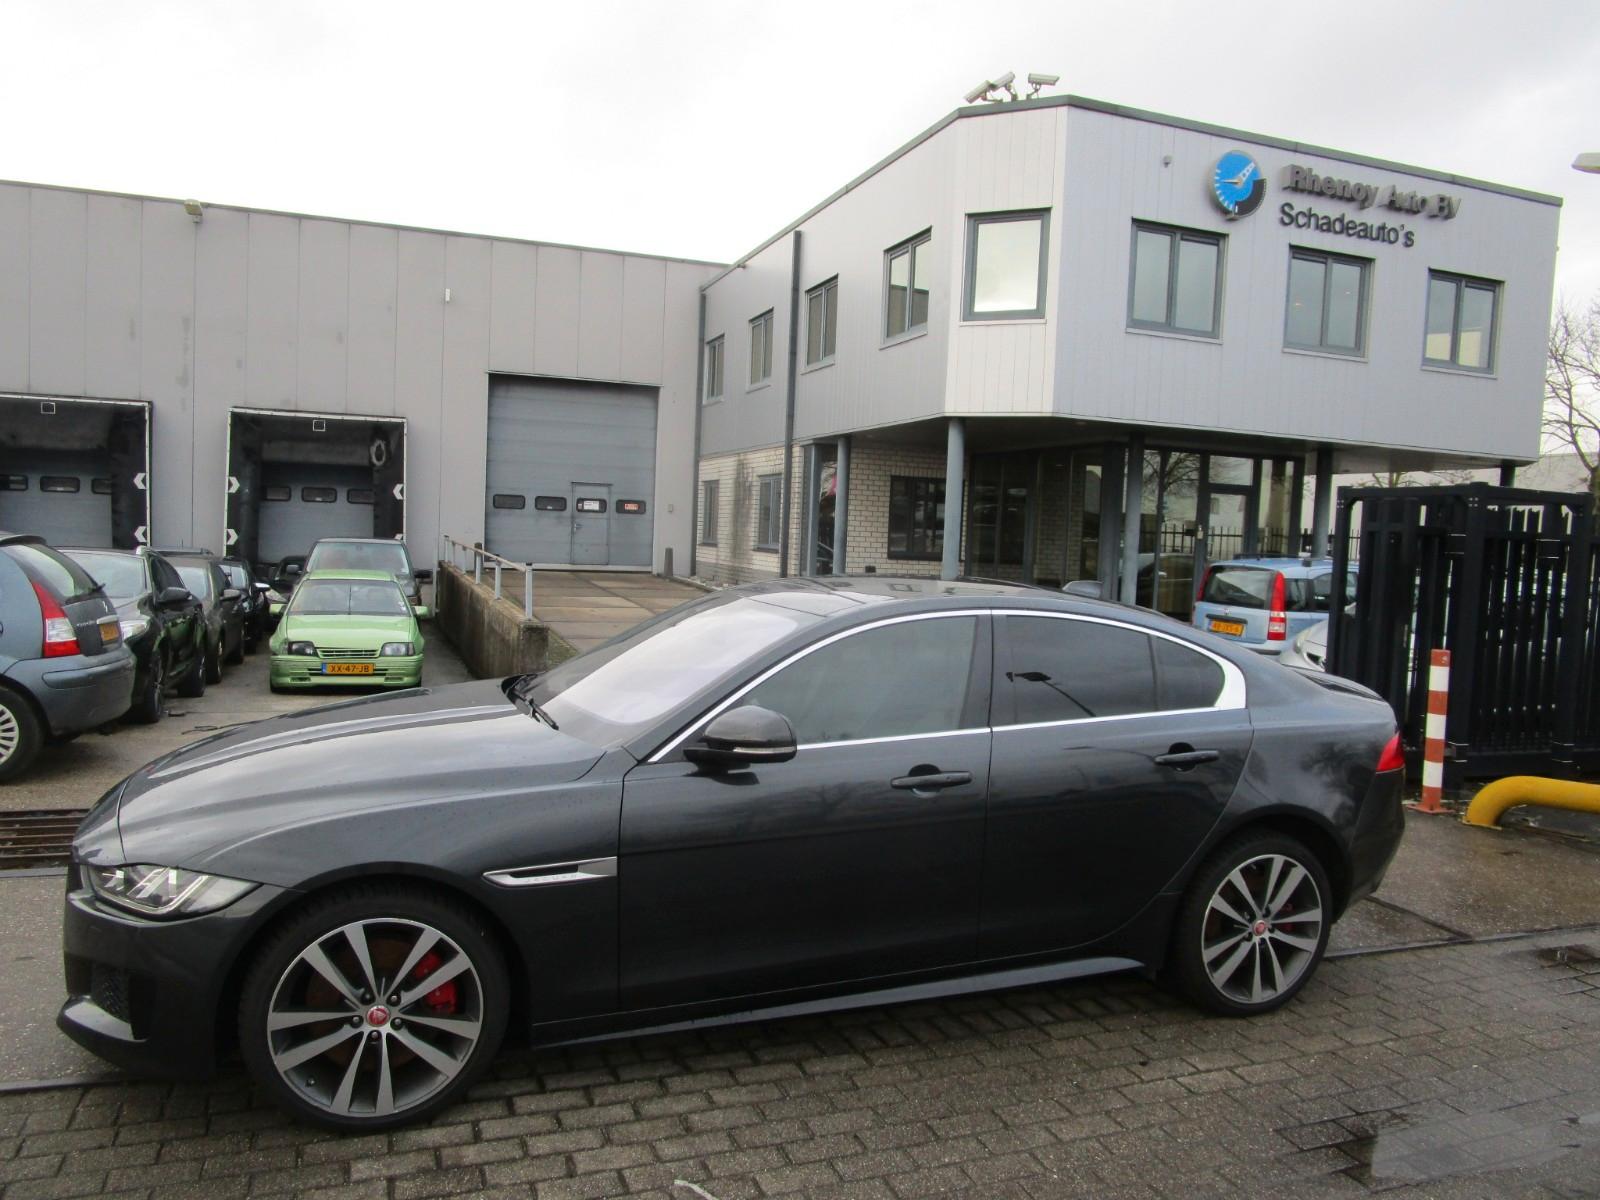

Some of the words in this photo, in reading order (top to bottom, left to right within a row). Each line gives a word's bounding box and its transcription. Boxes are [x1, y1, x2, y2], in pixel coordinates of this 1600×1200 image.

[1282, 164, 1379, 210] Rhenoy
[1380, 185, 1427, 214] Auto
[1428, 193, 1461, 219] BV
[1280, 202, 1415, 247] Schadeauto's
